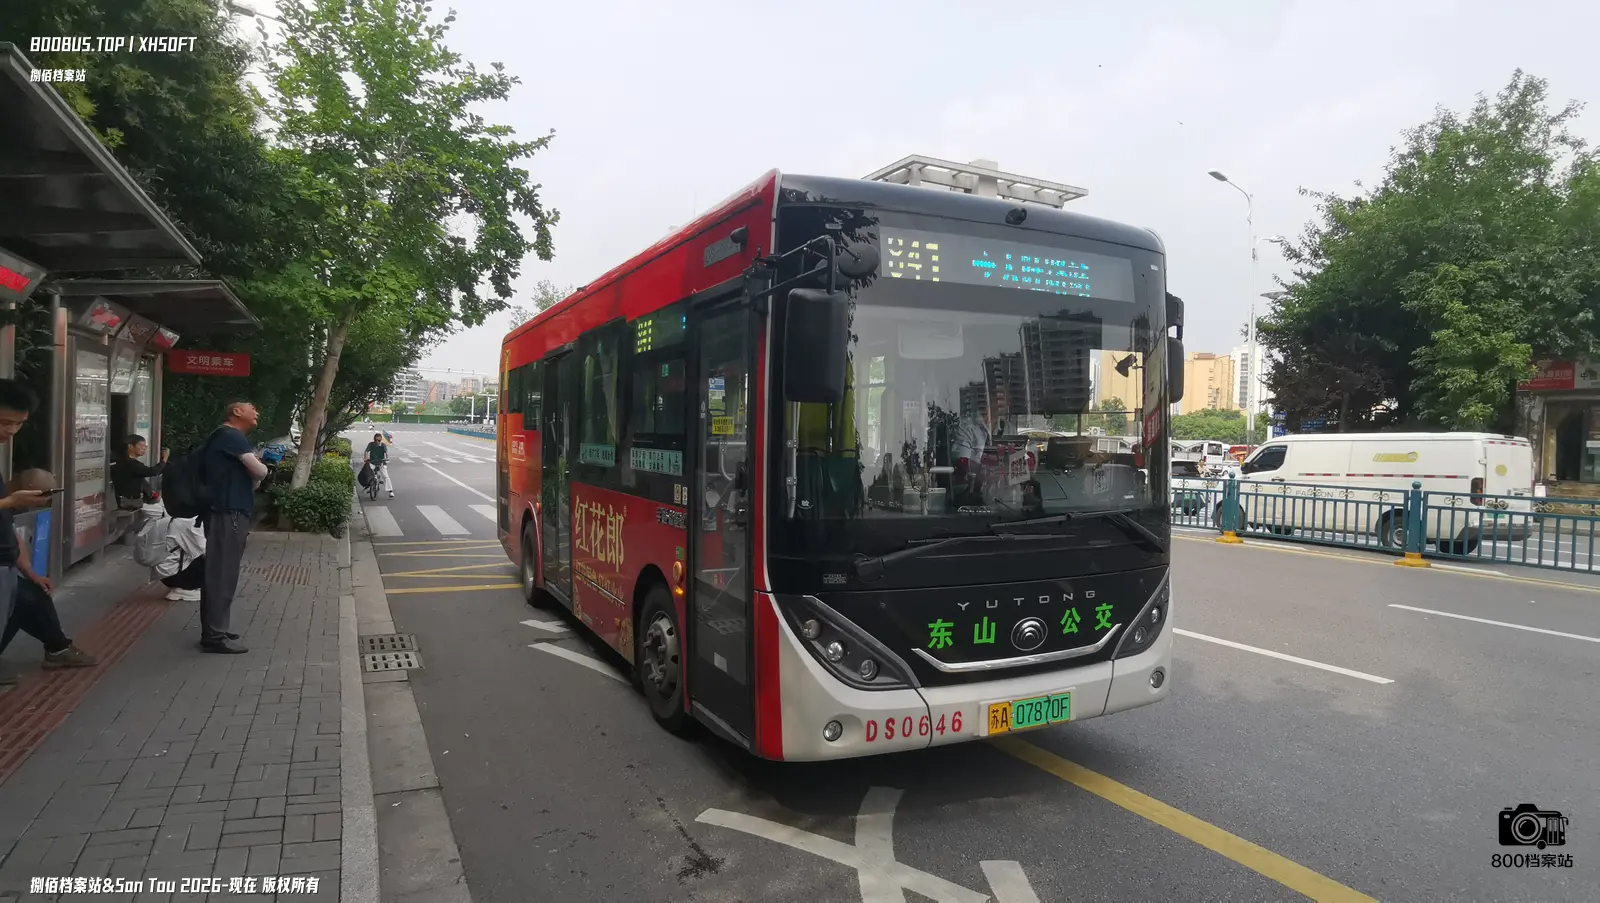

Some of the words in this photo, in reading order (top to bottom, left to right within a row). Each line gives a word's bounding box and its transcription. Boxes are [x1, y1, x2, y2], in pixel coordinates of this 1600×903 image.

[186, 355, 234, 367] 文明乘车
[574, 494, 625, 573] 红花郎
[957, 589, 1097, 611] YUTONG
[865, 710, 963, 743] DS0646
